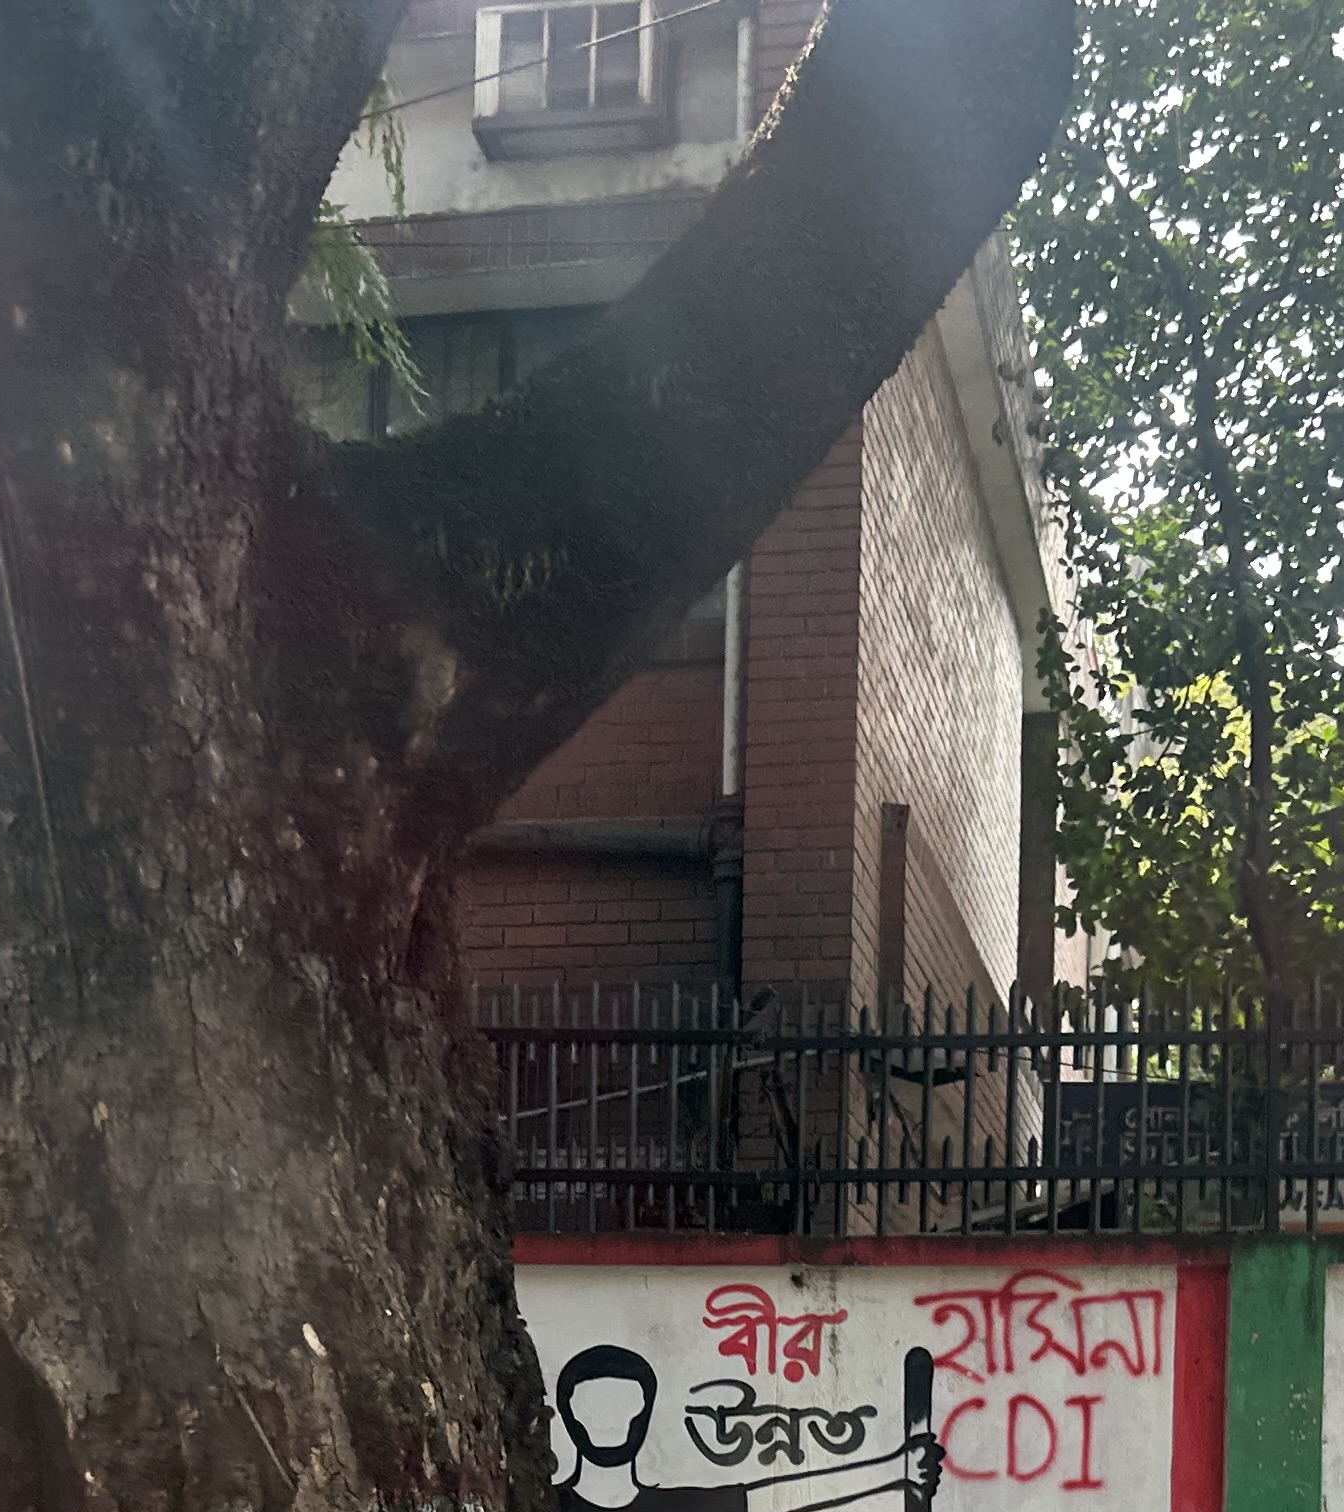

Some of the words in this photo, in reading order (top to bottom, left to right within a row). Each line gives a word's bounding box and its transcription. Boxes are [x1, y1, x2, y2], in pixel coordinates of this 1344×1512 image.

[703, 1283, 848, 1382] বীর
[914, 1269, 1164, 1382] হাসিনা
[684, 1379, 877, 1466] উন্নত
